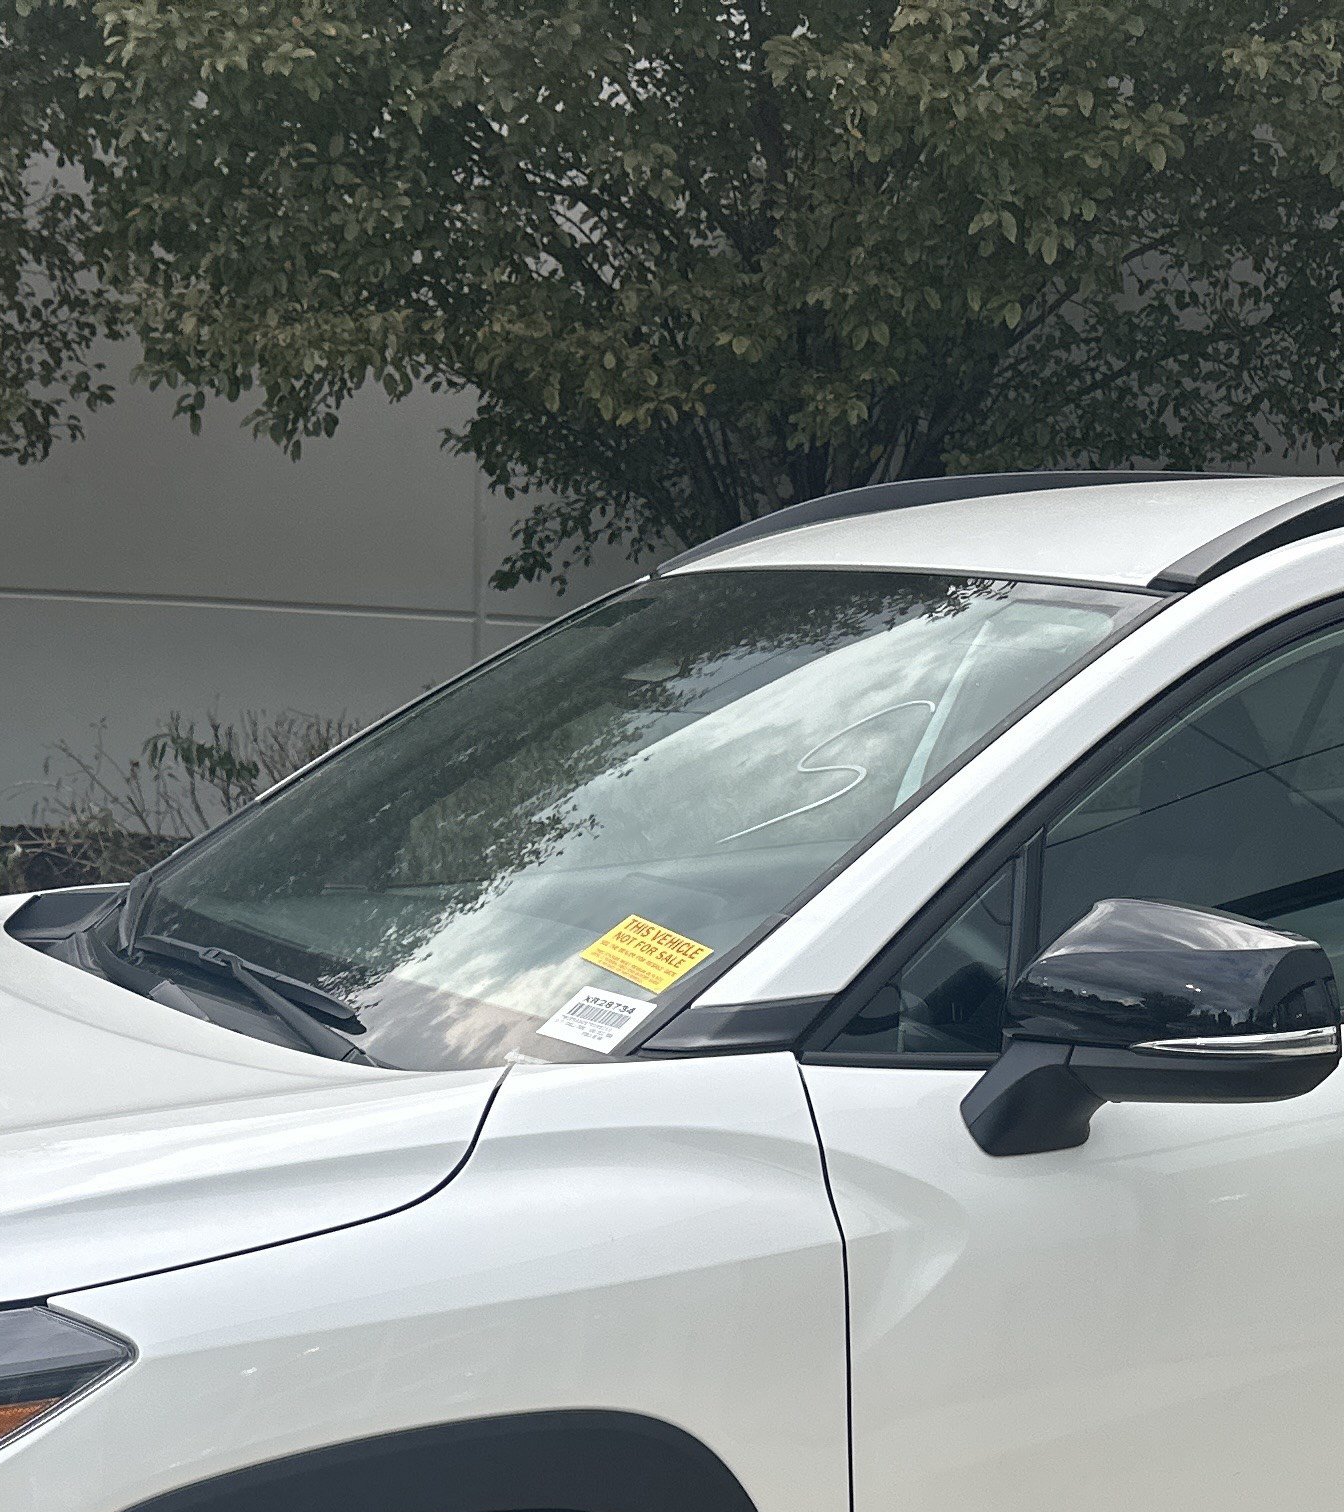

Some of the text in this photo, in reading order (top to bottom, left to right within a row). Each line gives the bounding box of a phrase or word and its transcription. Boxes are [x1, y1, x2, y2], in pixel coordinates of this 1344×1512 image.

[613, 930, 635, 946] NOT
[634, 940, 658, 956] FOR
[655, 950, 687, 969] SALE
[624, 918, 704, 960] THIS VEHICLE
